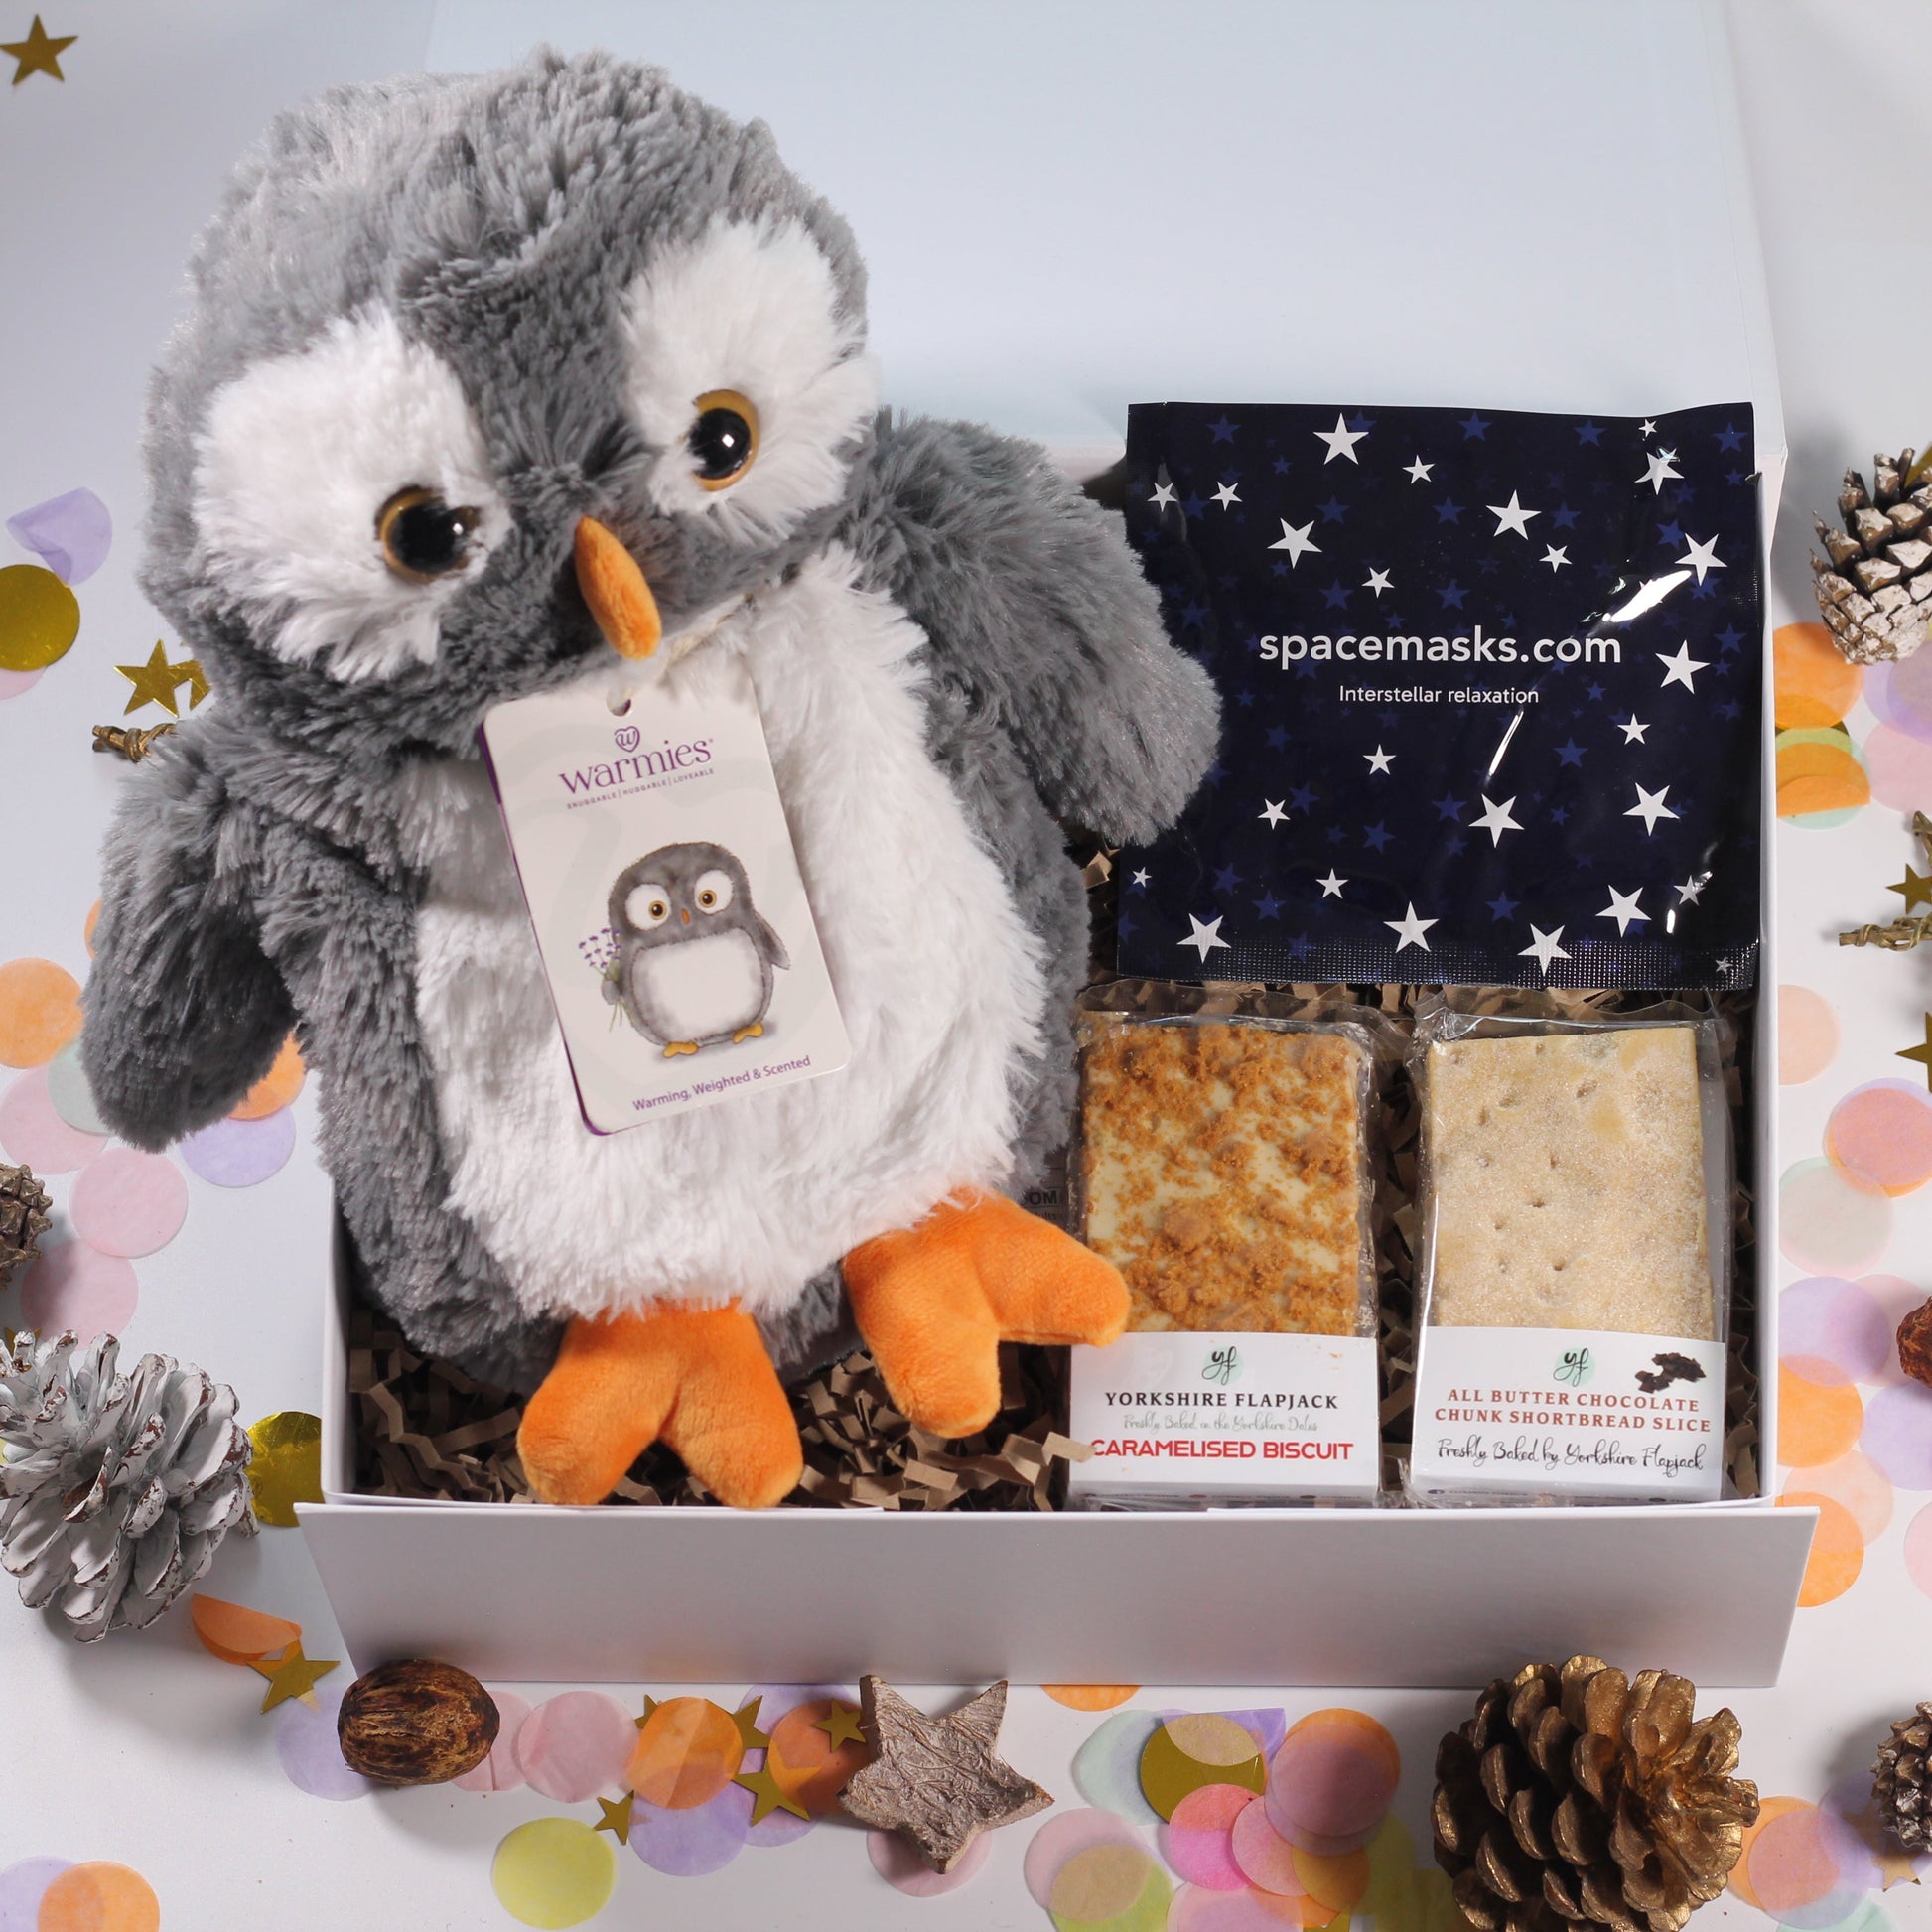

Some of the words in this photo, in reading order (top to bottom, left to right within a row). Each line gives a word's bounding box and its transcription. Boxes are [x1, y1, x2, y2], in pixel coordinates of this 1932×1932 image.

[1259, 625, 1621, 670] spacemasks.com
[1339, 685, 1442, 703] Interstellar
[1448, 686, 1539, 704] relaxation
[558, 739, 712, 794] warmies
[622, 779, 667, 795] HUGGABLE
[673, 767, 715, 784] LOVEABLE
[632, 1090, 692, 1111] Warming,
[692, 1070, 751, 1095] Weighted
[753, 1068, 762, 1080] &
[762, 1054, 811, 1077] Scented
[1105, 1391, 1227, 1407] YORKSHIRE
[1234, 1393, 1339, 1410] FLAPJACK
[1447, 1388, 1483, 1403] ALL
[1490, 1390, 1570, 1406] BUTTER
[1576, 1393, 1700, 1413] CHOCOLATE
[1123, 1411, 1161, 1434] Freshly
[1165, 1410, 1198, 1430] Baked
[1232, 1411, 1285, 1432] Yorkshire
[1435, 1408, 1503, 1423] CHUNK
[1508, 1410, 1646, 1429] SHORTBREAD
[1652, 1416, 1712, 1433] SLICE
[1091, 1439, 1256, 1458] CARAMELISED
[1263, 1442, 1354, 1460] BISCUIT
[1438, 1434, 1488, 1468] Freshly
[1492, 1435, 1540, 1462] Baked
[1564, 1438, 1637, 1466] Yorkshire
[1641, 1443, 1708, 1478] Flapjack
